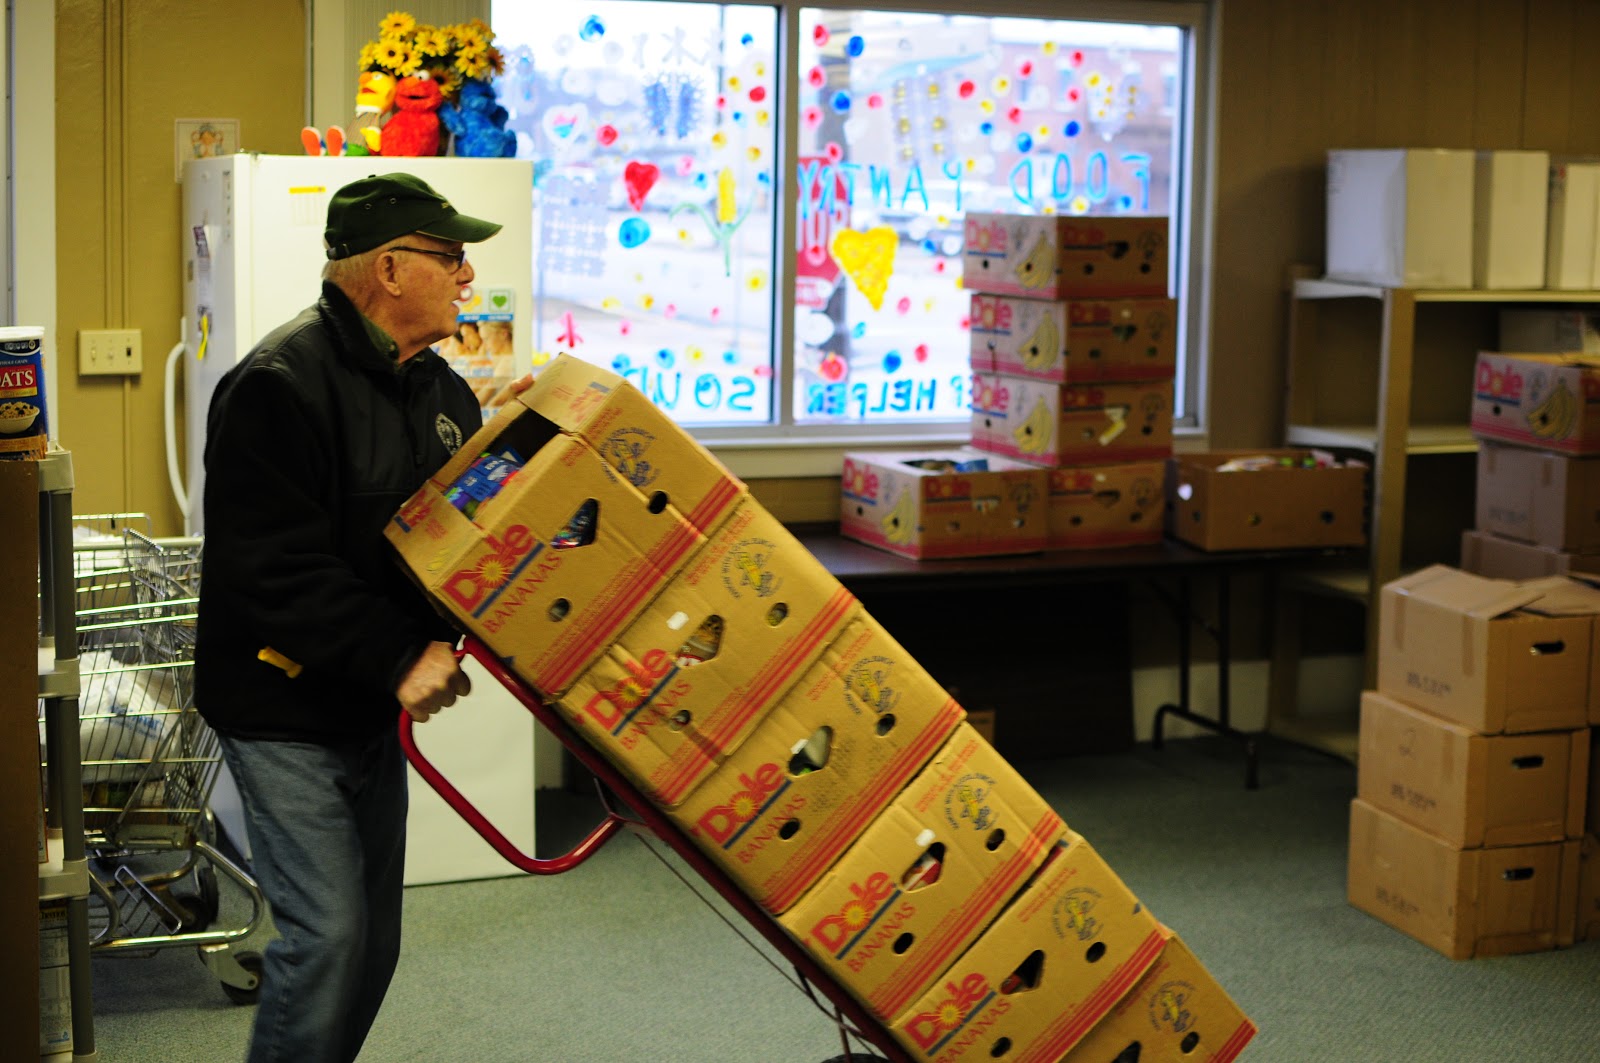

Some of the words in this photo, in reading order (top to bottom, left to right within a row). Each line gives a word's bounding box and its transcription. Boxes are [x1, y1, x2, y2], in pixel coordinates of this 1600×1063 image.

[0, 370, 34, 387] ATS
[441, 524, 536, 612] Dole
[482, 551, 561, 634] BANANAS
[582, 648, 674, 731] Dole
[620, 681, 692, 750] BANANAS
[698, 762, 784, 844] Dole
[736, 793, 807, 864] BANANAS
[810, 871, 893, 953] Dole
[847, 902, 916, 973] BANANAS
[903, 972, 990, 1050] Dole
